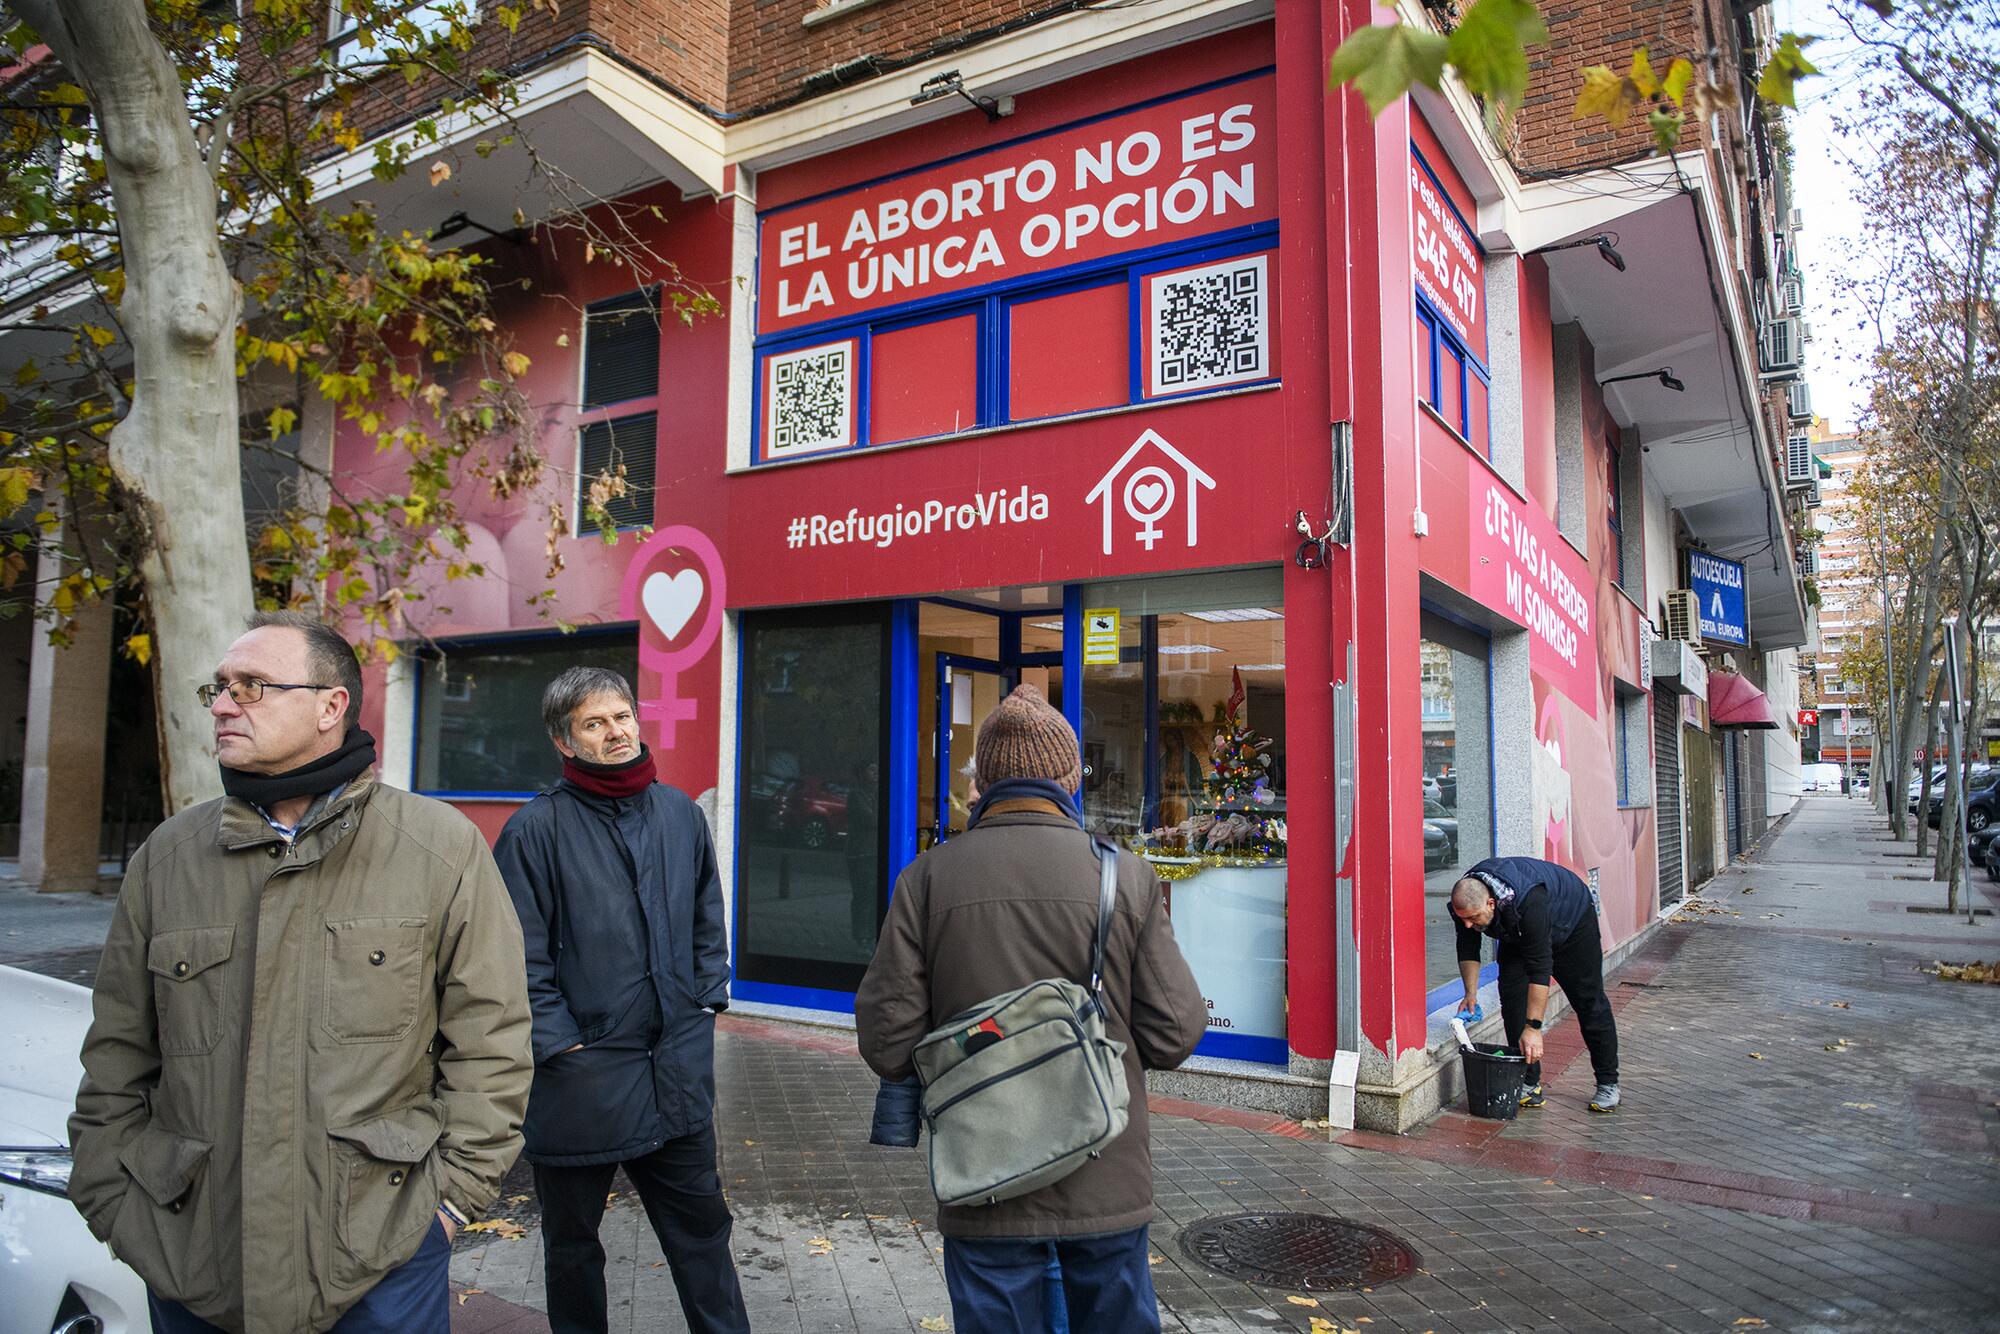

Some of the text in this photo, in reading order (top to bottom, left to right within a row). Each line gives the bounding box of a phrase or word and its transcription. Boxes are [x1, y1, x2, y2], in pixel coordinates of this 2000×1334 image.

[780, 104, 1256, 268] EL ABORTO NO ES
[1420, 180, 1441, 222] este
[1441, 207, 1477, 274] teléfono
[778, 163, 1255, 318] LA ÚNICA OPCIÓN
[1417, 210, 1477, 324] 545 417
[787, 485, 1049, 549] #RefugioProVida
[1485, 486, 1589, 635] ¿TE VAS A PERDER
[1506, 561, 1577, 669] MI SONRISA?
[1691, 555, 1742, 589] AUTOESCUELA
[1700, 618, 1744, 640] ERTA EUROPA
[1207, 1016, 1235, 1028] ano.
